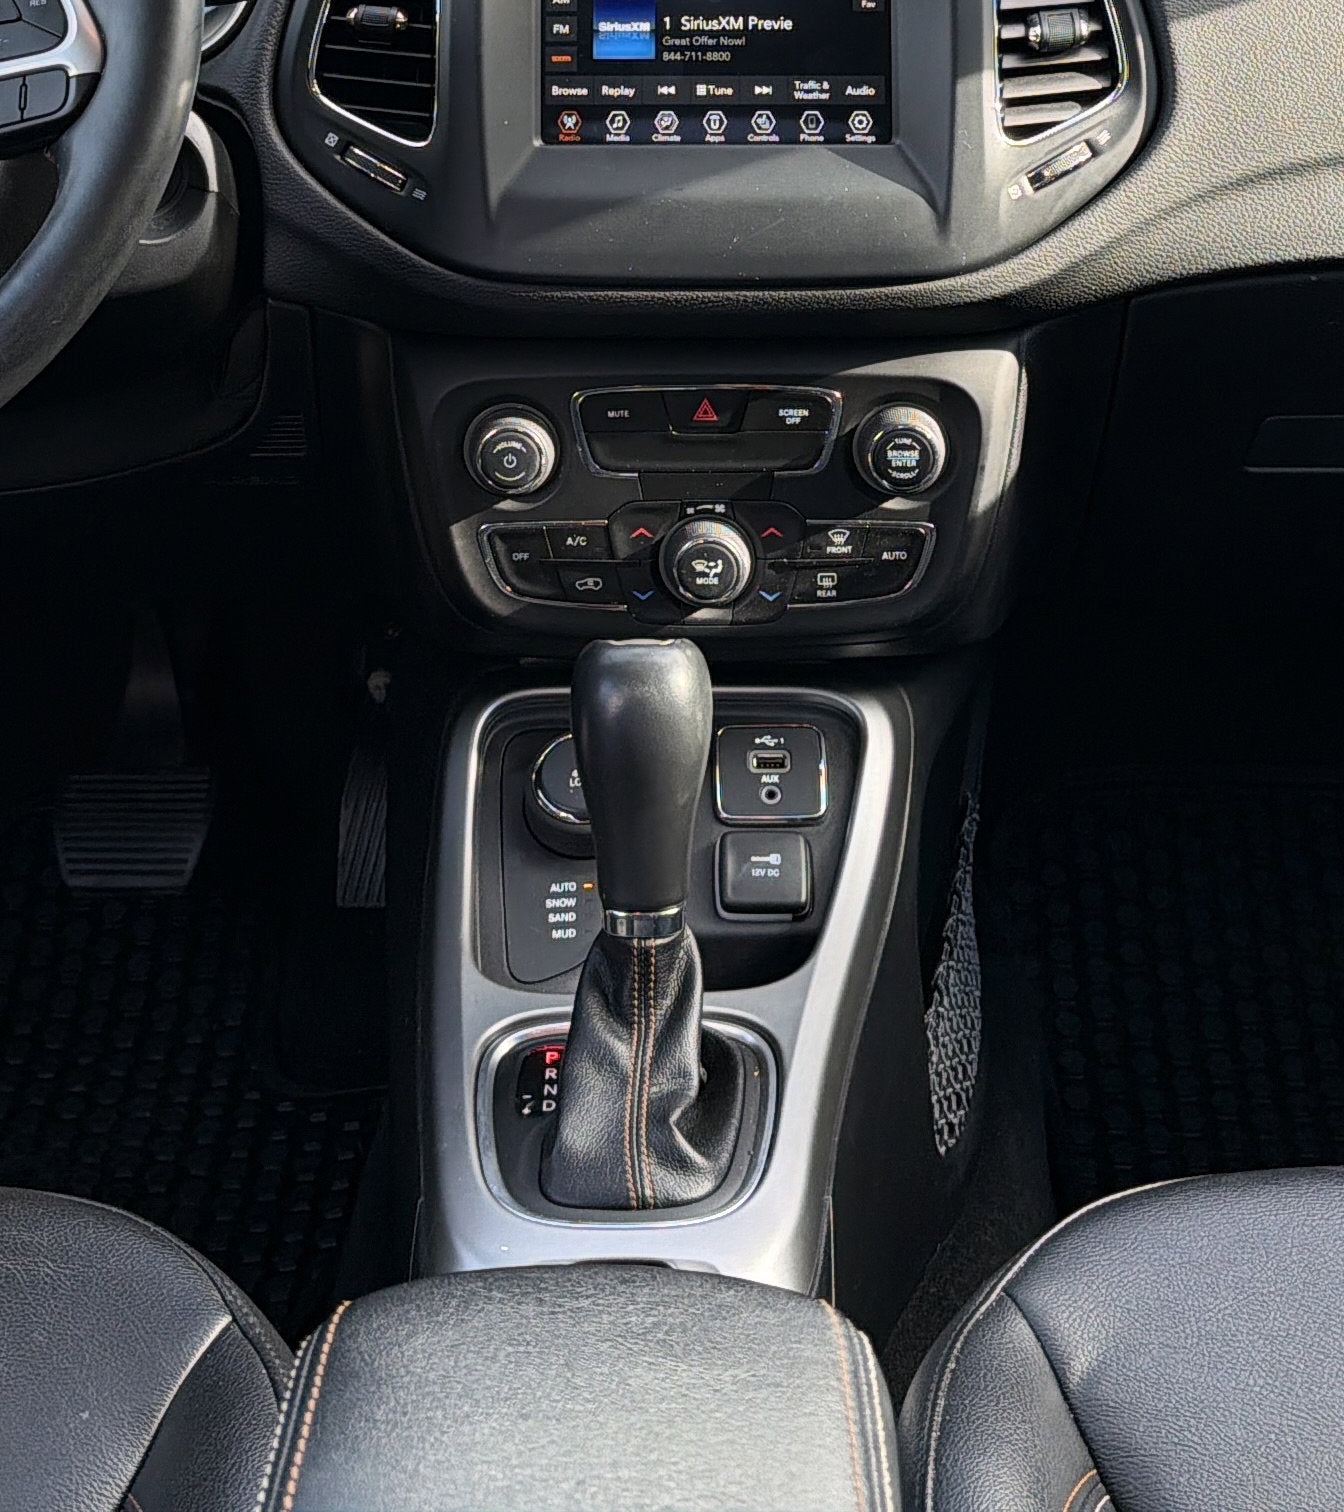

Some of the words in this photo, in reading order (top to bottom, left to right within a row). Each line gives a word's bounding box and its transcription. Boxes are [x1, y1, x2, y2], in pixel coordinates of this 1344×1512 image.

[861, 0, 877, 9] Fav
[598, 21, 651, 32] SiriusXM
[663, 16, 670, 30] 1
[680, 16, 743, 30] SiriusXM
[748, 16, 793, 30] Previe
[553, 24, 570, 34] FM
[662, 36, 690, 46] Great
[692, 36, 718, 46] Offer
[720, 36, 746, 46] Now!
[662, 51, 731, 61] 844-711-8800
[794, 80, 822, 90] Traffic
[551, 85, 588, 96] Browse
[602, 85, 636, 98] Replay
[708, 85, 733, 96] Tune
[845, 86, 876, 96] Audio
[794, 91, 830, 100] Weather
[559, 134, 581, 142] Radio
[606, 134, 630, 142] Media
[652, 134, 682, 142] Climate
[704, 134, 726, 143] Apps
[747, 134, 780, 142] Controls
[800, 134, 825, 142] Phone
[845, 134, 876, 143] Settings
[607, 410, 630, 418] MUTE
[778, 408, 809, 417] SCREEN
[785, 417, 801, 425] OFF
[894, 437, 913, 446] TUNE
[886, 450, 920, 459] BROWSE
[891, 459, 917, 467] ENTER
[891, 471, 916, 480] SCROLL
[566, 536, 587, 546] A/C
[826, 546, 853, 554] FRONT
[512, 552, 530, 561] OFF
[881, 552, 908, 561] AUTO
[696, 577, 719, 585] MODE
[816, 589, 837, 598] REAR
[760, 774, 780, 784] AUX
[751, 868, 766, 877] 12V
[767, 868, 780, 877] DC
[550, 882, 577, 892] AUTO
[545, 897, 577, 909] SNOW
[548, 912, 576, 923] SAND
[551, 928, 577, 939] MUD
[546, 1051, 560, 1064] P
[545, 1068, 558, 1080] R
[543, 1083, 558, 1096] N
[542, 1099, 556, 1112] D
